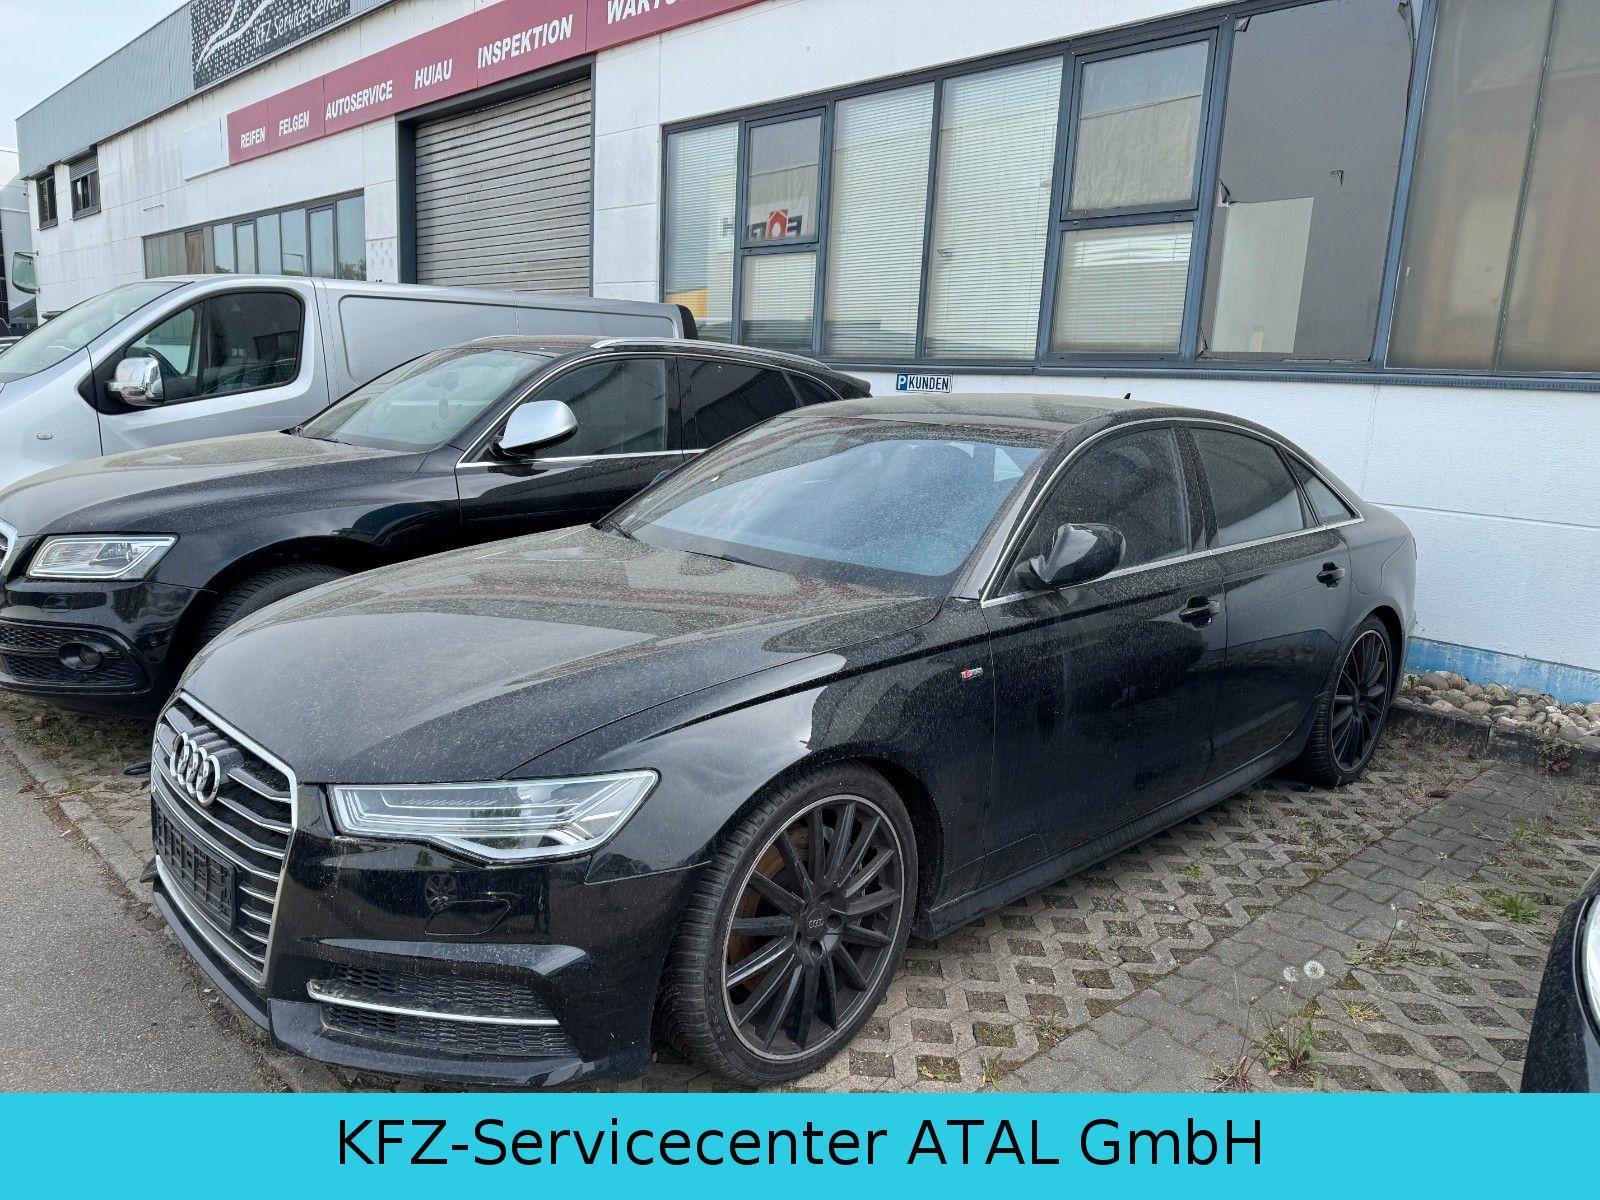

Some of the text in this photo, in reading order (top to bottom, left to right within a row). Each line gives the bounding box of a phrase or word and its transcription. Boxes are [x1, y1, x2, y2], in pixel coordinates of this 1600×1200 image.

[254, 0, 344, 47] KFZ Service-Cente
[240, 126, 266, 149] REIFEN
[278, 110, 310, 137] FELGEN
[325, 79, 393, 121] AUTOSERVICE
[477, 14, 573, 69] INSPEKTION
[898, 375, 949, 390] P KUNDEN
